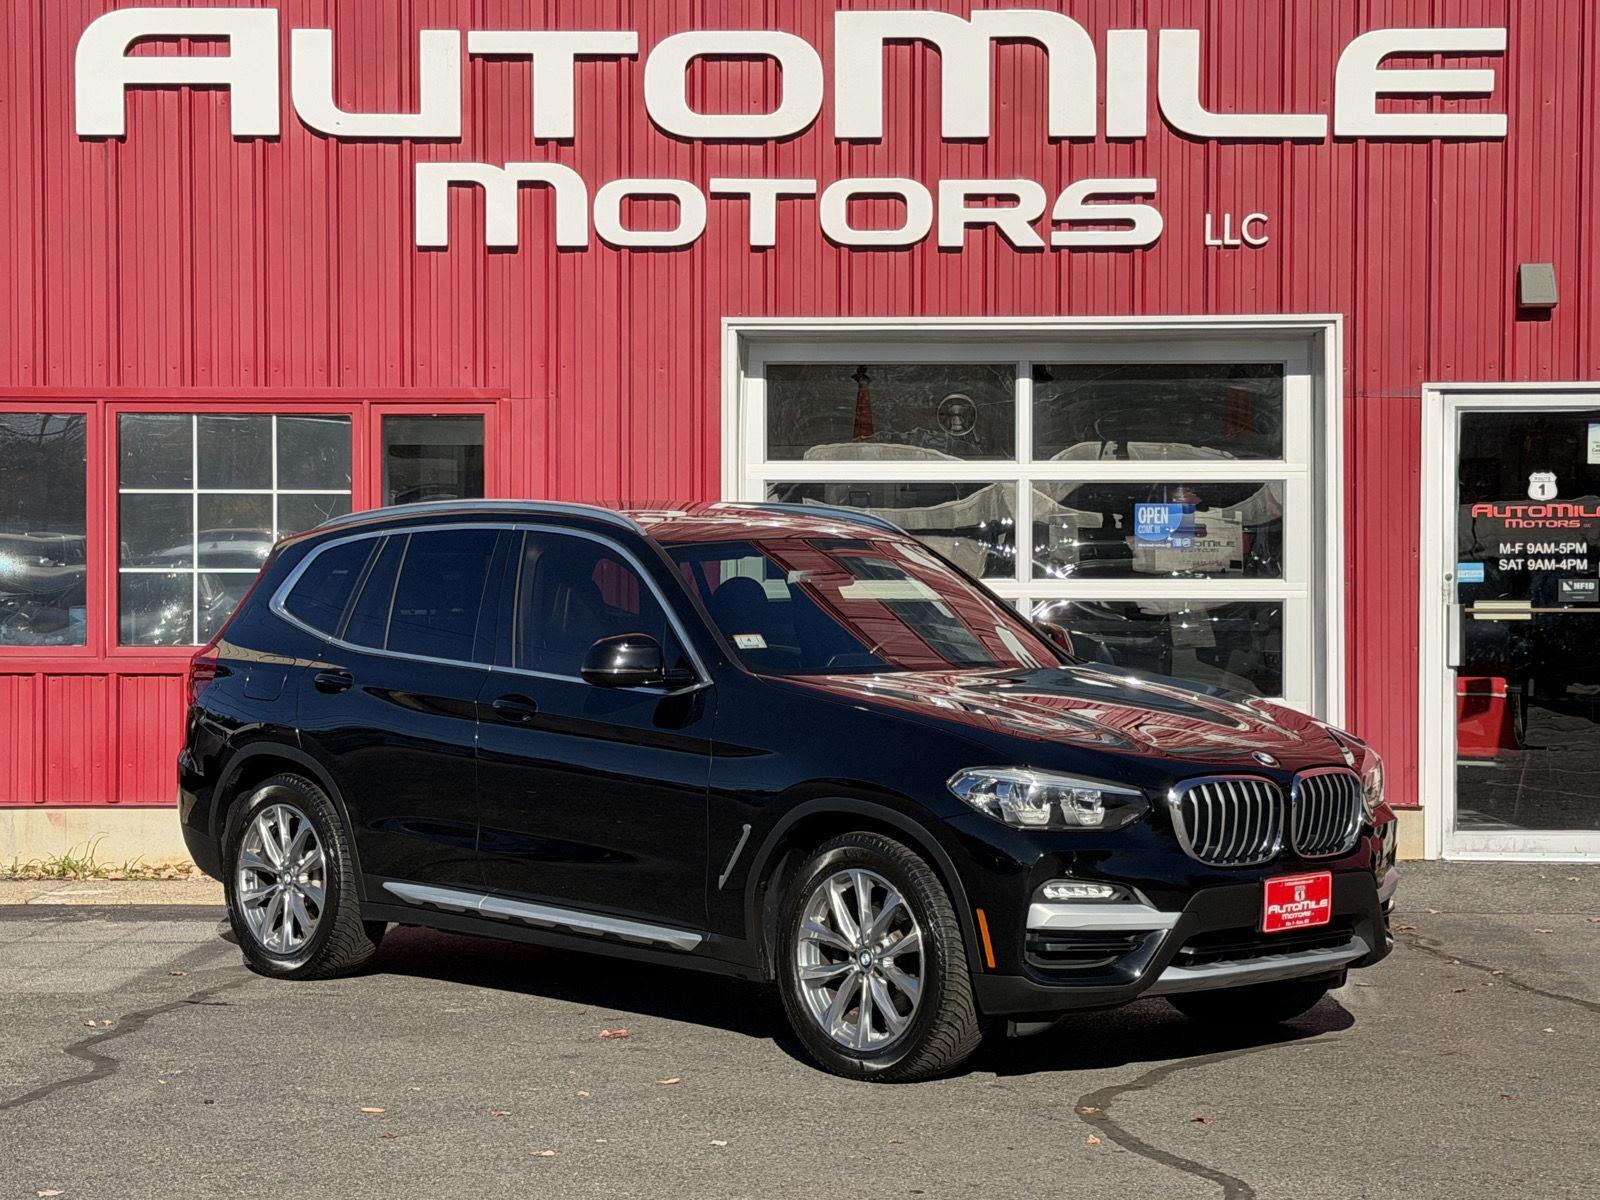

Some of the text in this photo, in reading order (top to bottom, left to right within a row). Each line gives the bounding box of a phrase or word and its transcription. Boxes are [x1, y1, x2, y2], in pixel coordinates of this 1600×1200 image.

[75, 8, 1507, 139] AUTOMILE
[415, 162, 1270, 249] MOTORS LLC
[1538, 483, 1546, 496] 1
[1138, 506, 1169, 524] OPEN
[1505, 519, 1581, 528] MOTORS
[1499, 543, 1588, 554] M-F 9AM-5PM
[1498, 559, 1588, 570] SAT 9AM-4PM
[1268, 899, 1329, 915] AUTOMILE
